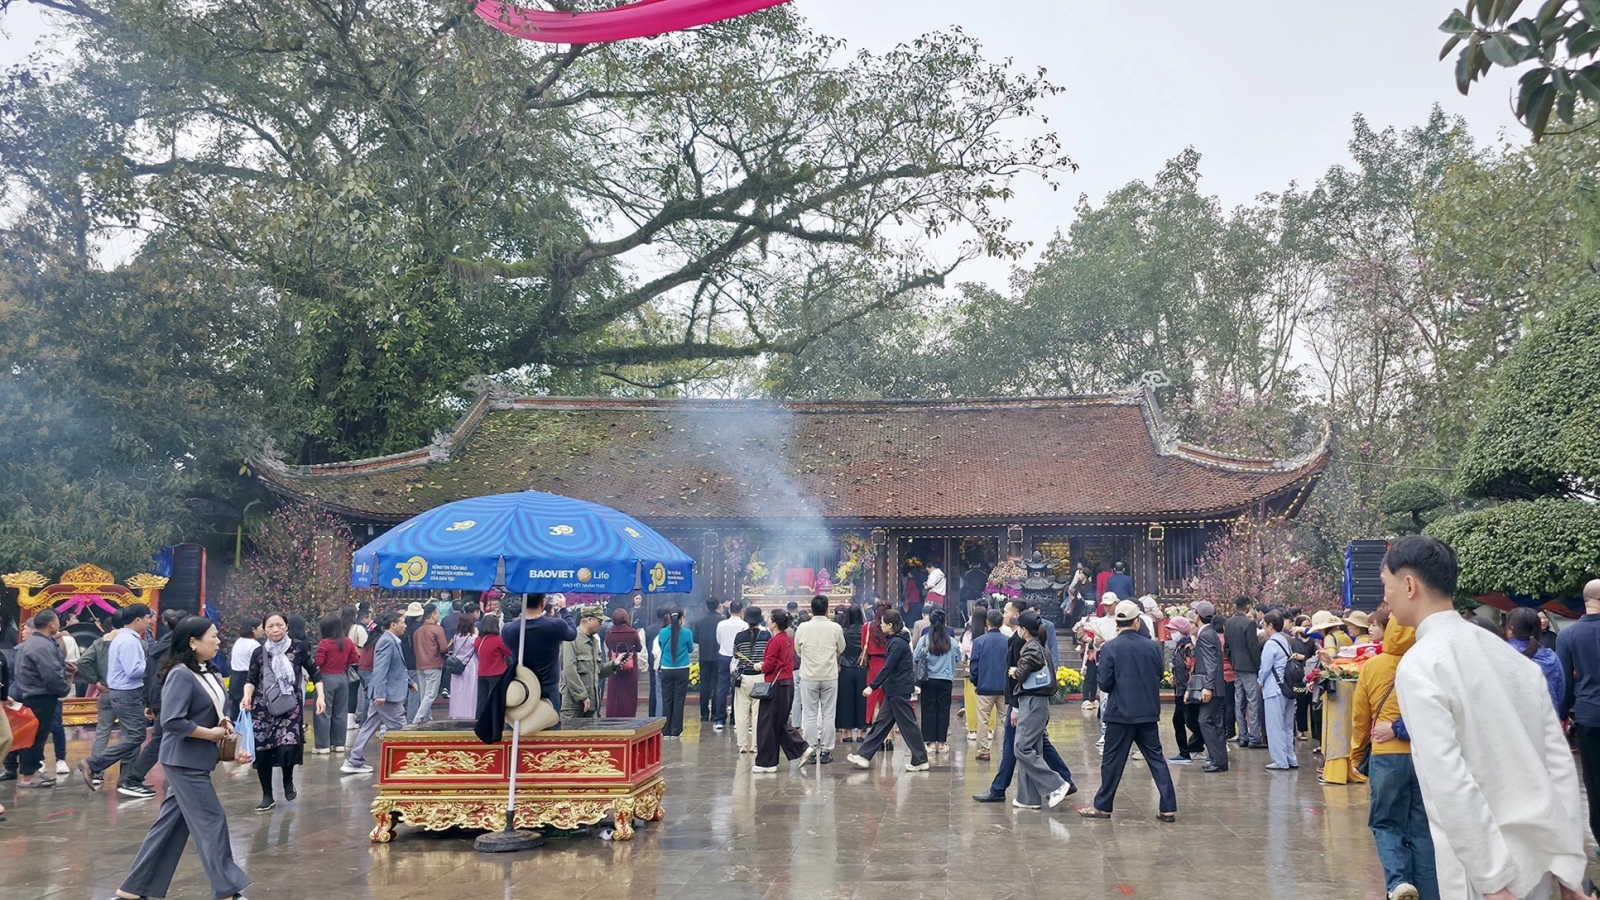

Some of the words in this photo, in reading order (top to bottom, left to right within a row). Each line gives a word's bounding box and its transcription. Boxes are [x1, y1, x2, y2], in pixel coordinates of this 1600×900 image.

[391, 555, 428, 587] 30
[529, 569, 575, 579] BAOVIET
[593, 570, 610, 580] Life
[648, 562, 666, 592] 30
